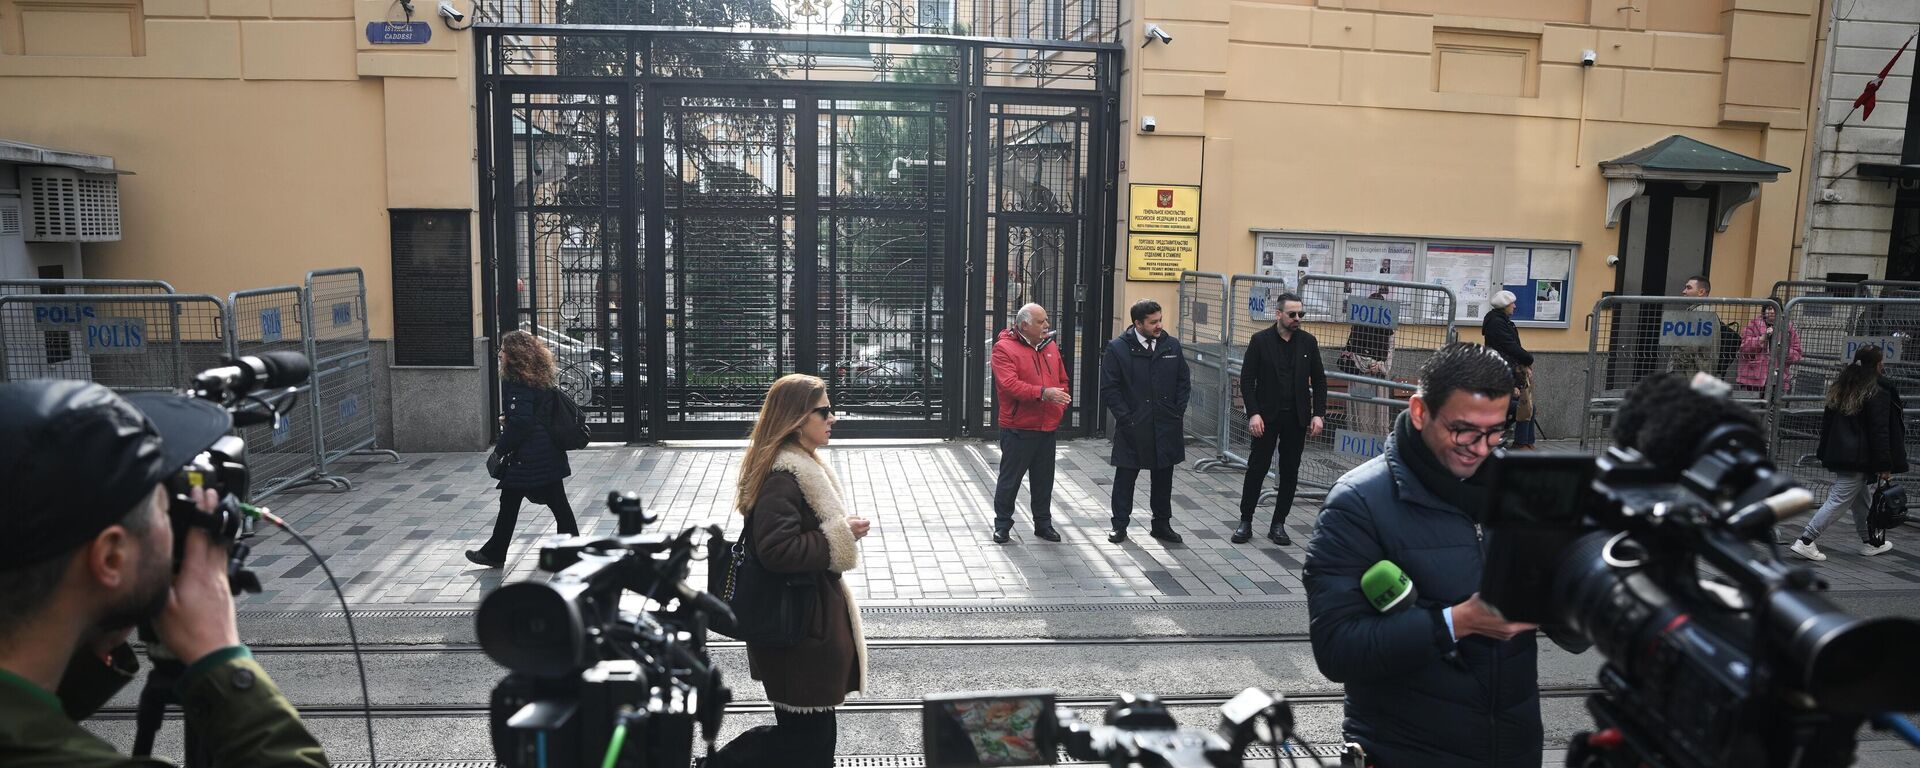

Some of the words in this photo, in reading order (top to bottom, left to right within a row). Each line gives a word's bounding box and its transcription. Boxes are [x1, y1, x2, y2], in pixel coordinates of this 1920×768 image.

[1350, 304, 1392, 326] POLİS
[88, 320, 141, 348] POLİS
[1662, 318, 1712, 336] POLİS
[1846, 338, 1894, 360] PİS
